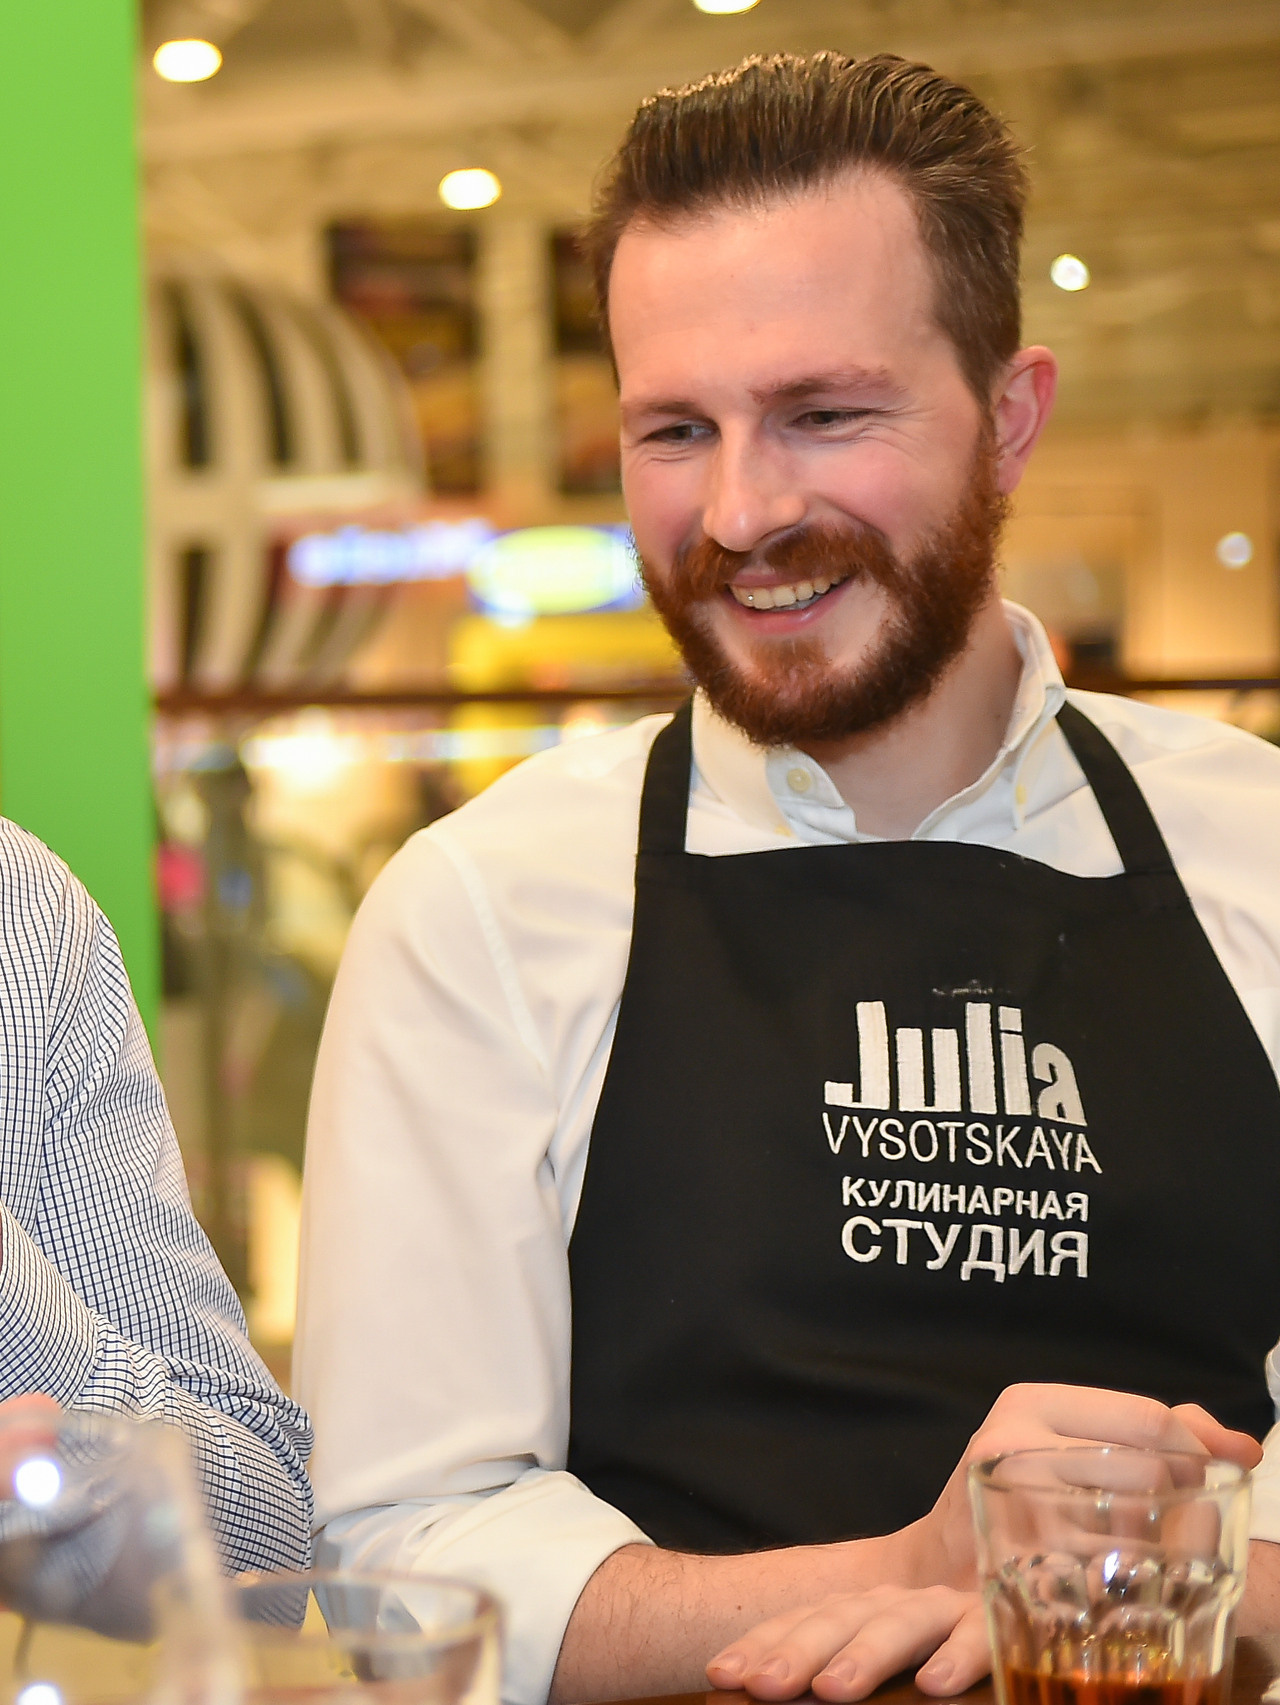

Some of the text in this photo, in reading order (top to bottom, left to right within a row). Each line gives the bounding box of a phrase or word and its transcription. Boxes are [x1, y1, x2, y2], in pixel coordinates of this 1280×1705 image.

[824, 1000, 1088, 1127] Julia
[822, 1111, 1103, 1174] VYSOTSKAYA
[841, 1175, 1090, 1223] КУЛИНАРНАЯ
[841, 1214, 1089, 1284] СТУДИЯ
